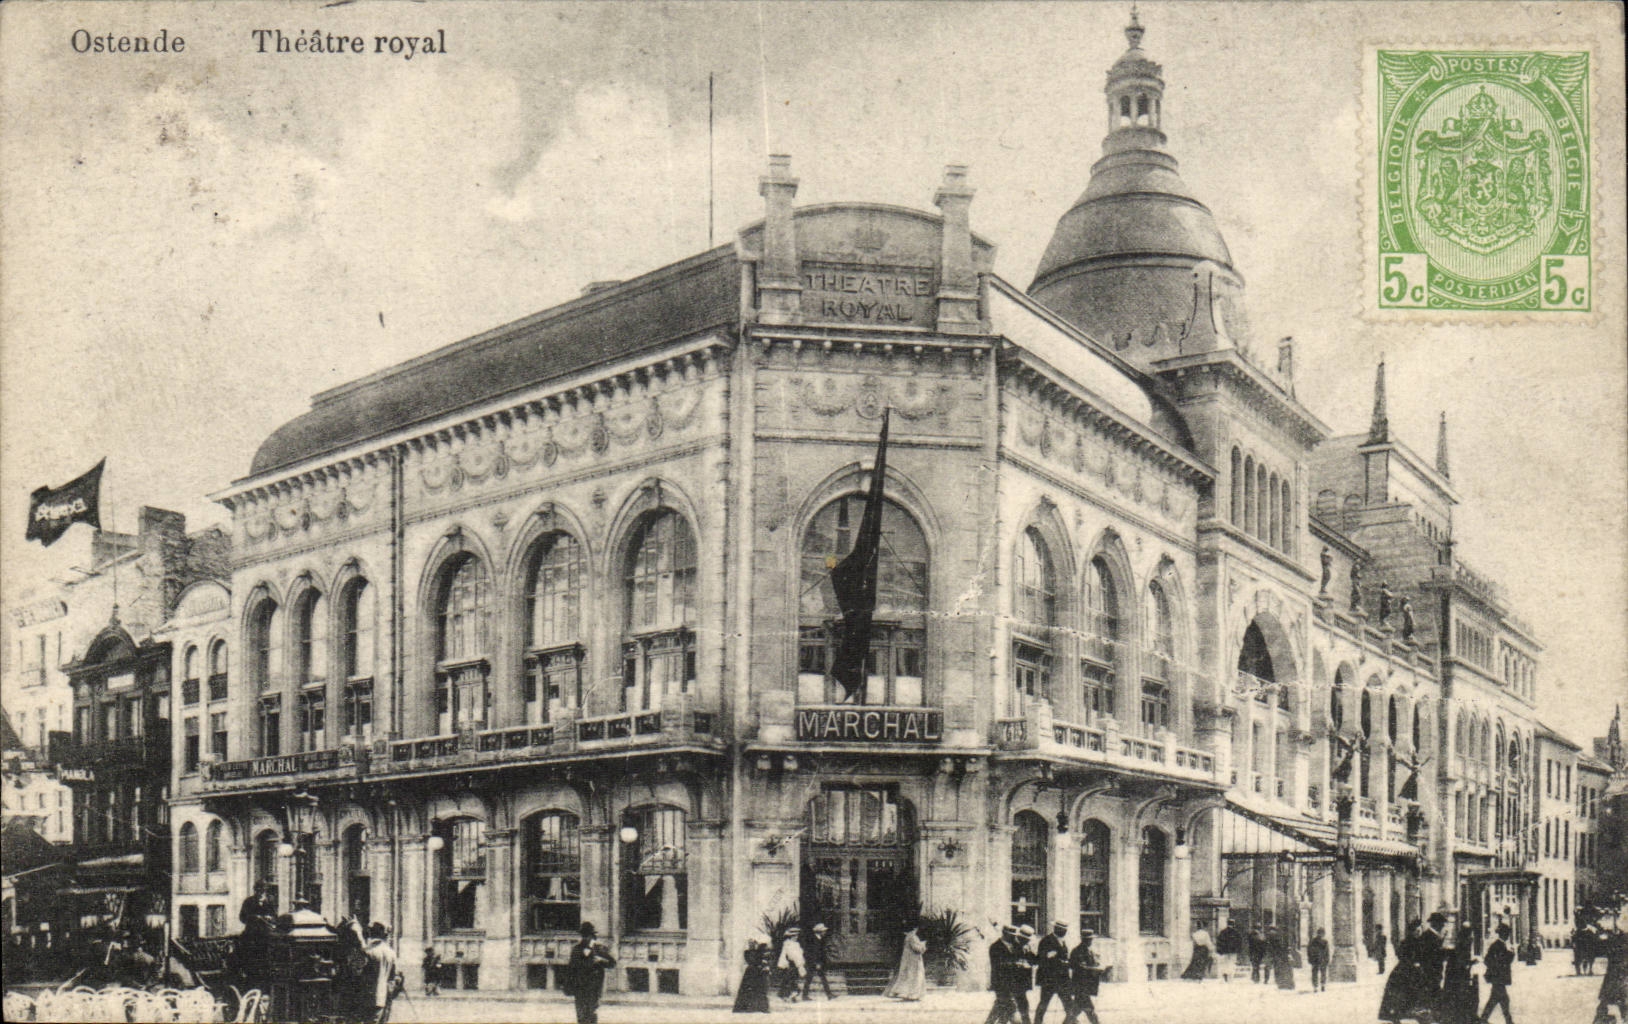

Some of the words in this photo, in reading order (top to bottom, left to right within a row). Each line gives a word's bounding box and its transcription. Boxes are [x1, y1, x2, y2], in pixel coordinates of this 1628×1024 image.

[806, 273, 930, 297] THEATRE
[822, 299, 912, 322] ROYAL
[798, 710, 939, 740] MARCHAL
[251, 756, 297, 776] MARCHAL
